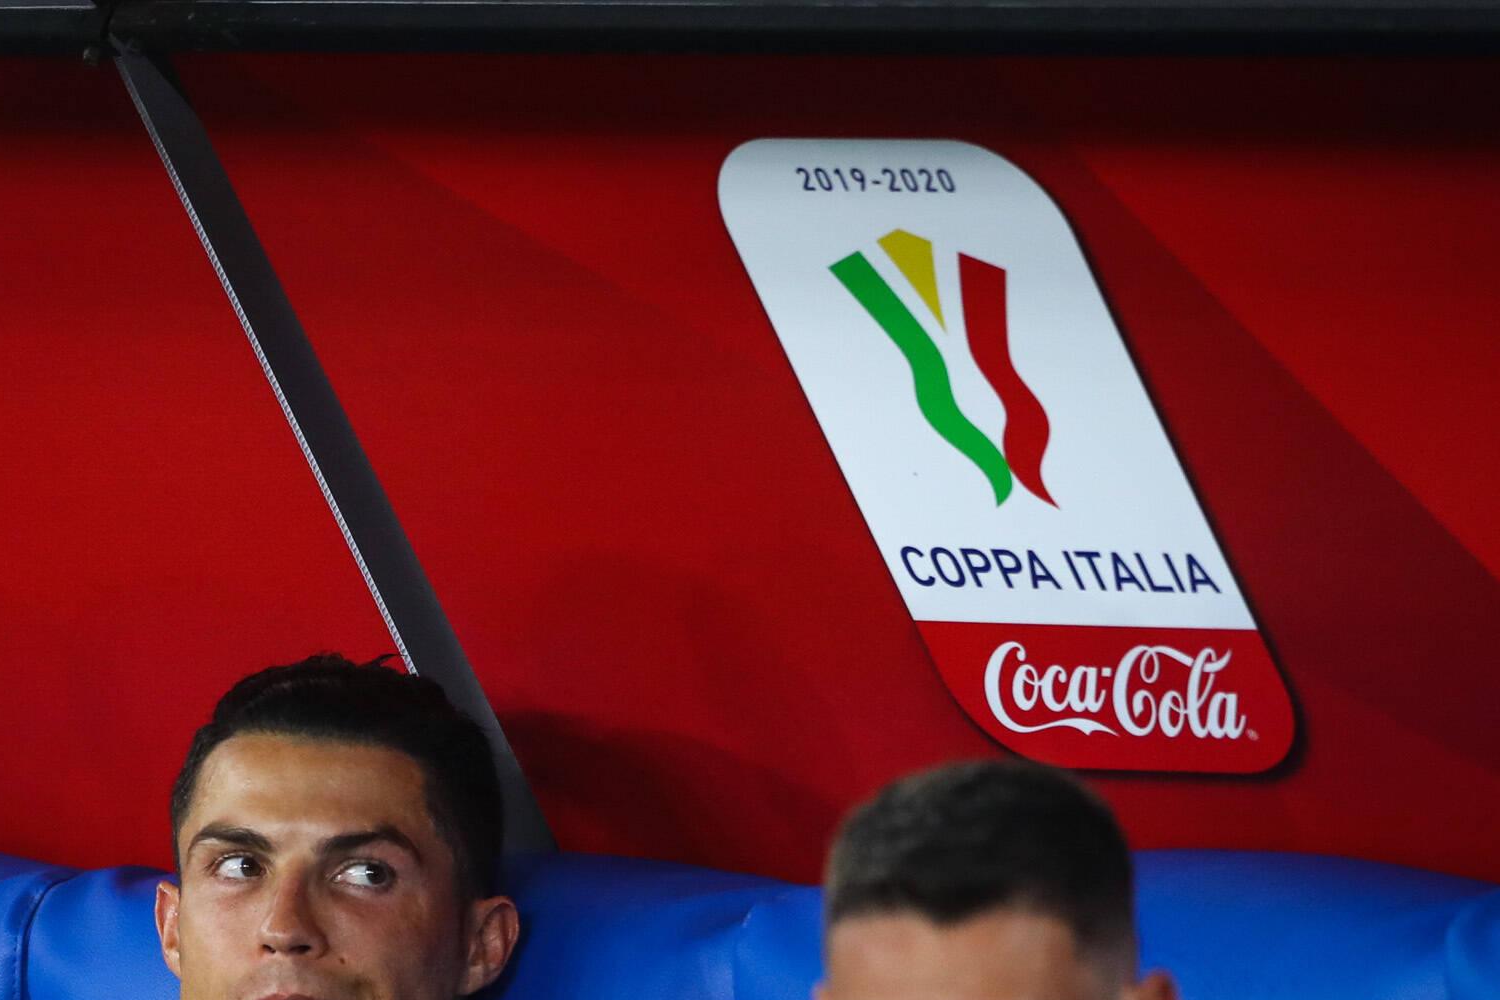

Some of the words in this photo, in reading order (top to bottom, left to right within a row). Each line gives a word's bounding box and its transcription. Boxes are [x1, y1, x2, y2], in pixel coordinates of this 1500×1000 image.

[795, 167, 956, 194] 2019-2020
[900, 545, 1061, 590] COPPA
[1062, 549, 1221, 594] ITALIA
[984, 640, 1246, 739] Coca-Cola
